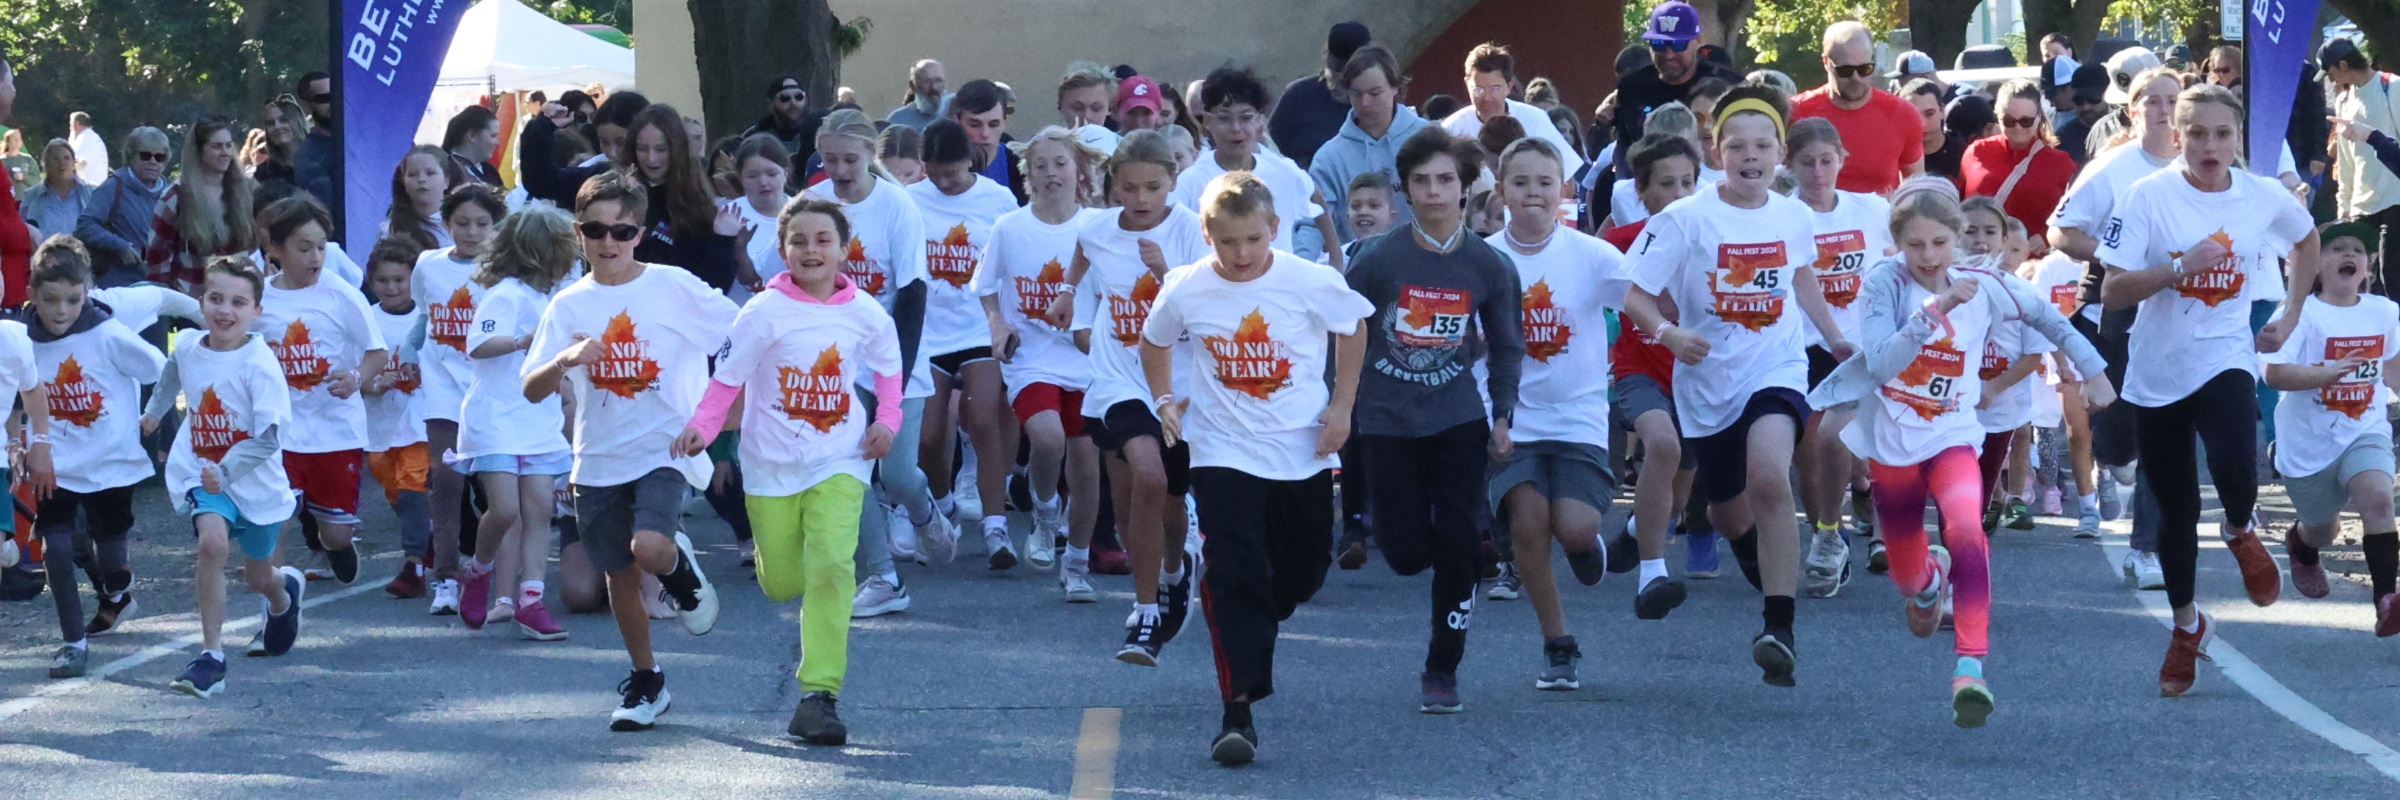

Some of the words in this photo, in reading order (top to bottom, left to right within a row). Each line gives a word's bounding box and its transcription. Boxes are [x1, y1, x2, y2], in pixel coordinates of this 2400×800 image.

[1657, 15, 1680, 33] W
[927, 243, 946, 257] DO
[949, 244, 979, 261] NOT
[1744, 247, 1760, 255] FEST
[1760, 246, 1777, 254] 2024
[931, 257, 972, 273] FEAR!
[1832, 252, 1864, 272] 207
[1021, 280, 1041, 295] DO
[1753, 269, 1778, 289] 45
[1408, 289, 1425, 298] FALL
[1425, 291, 1441, 299] FEST
[1442, 293, 1460, 301] 2024
[434, 306, 450, 320] DO
[453, 307, 473, 321] NO
[1114, 299, 1137, 316] DO
[1529, 307, 1566, 326] NOT
[1430, 315, 1462, 335] 135
[289, 342, 320, 359] NOT
[609, 340, 650, 359] NOT
[1212, 340, 1239, 358] DO
[1243, 340, 1284, 360] NOT
[1924, 349, 1941, 359] FEST
[1941, 352, 1960, 362] 2024
[590, 360, 645, 379] FEAR!
[1221, 360, 1278, 378] FEAR!
[1374, 357, 1464, 386] BASKETBALL
[2355, 360, 2379, 379] 123
[785, 371, 813, 391] DO
[1928, 376, 1953, 398] 61
[789, 391, 842, 412] FEAR!
[204, 412, 238, 431] NOT
